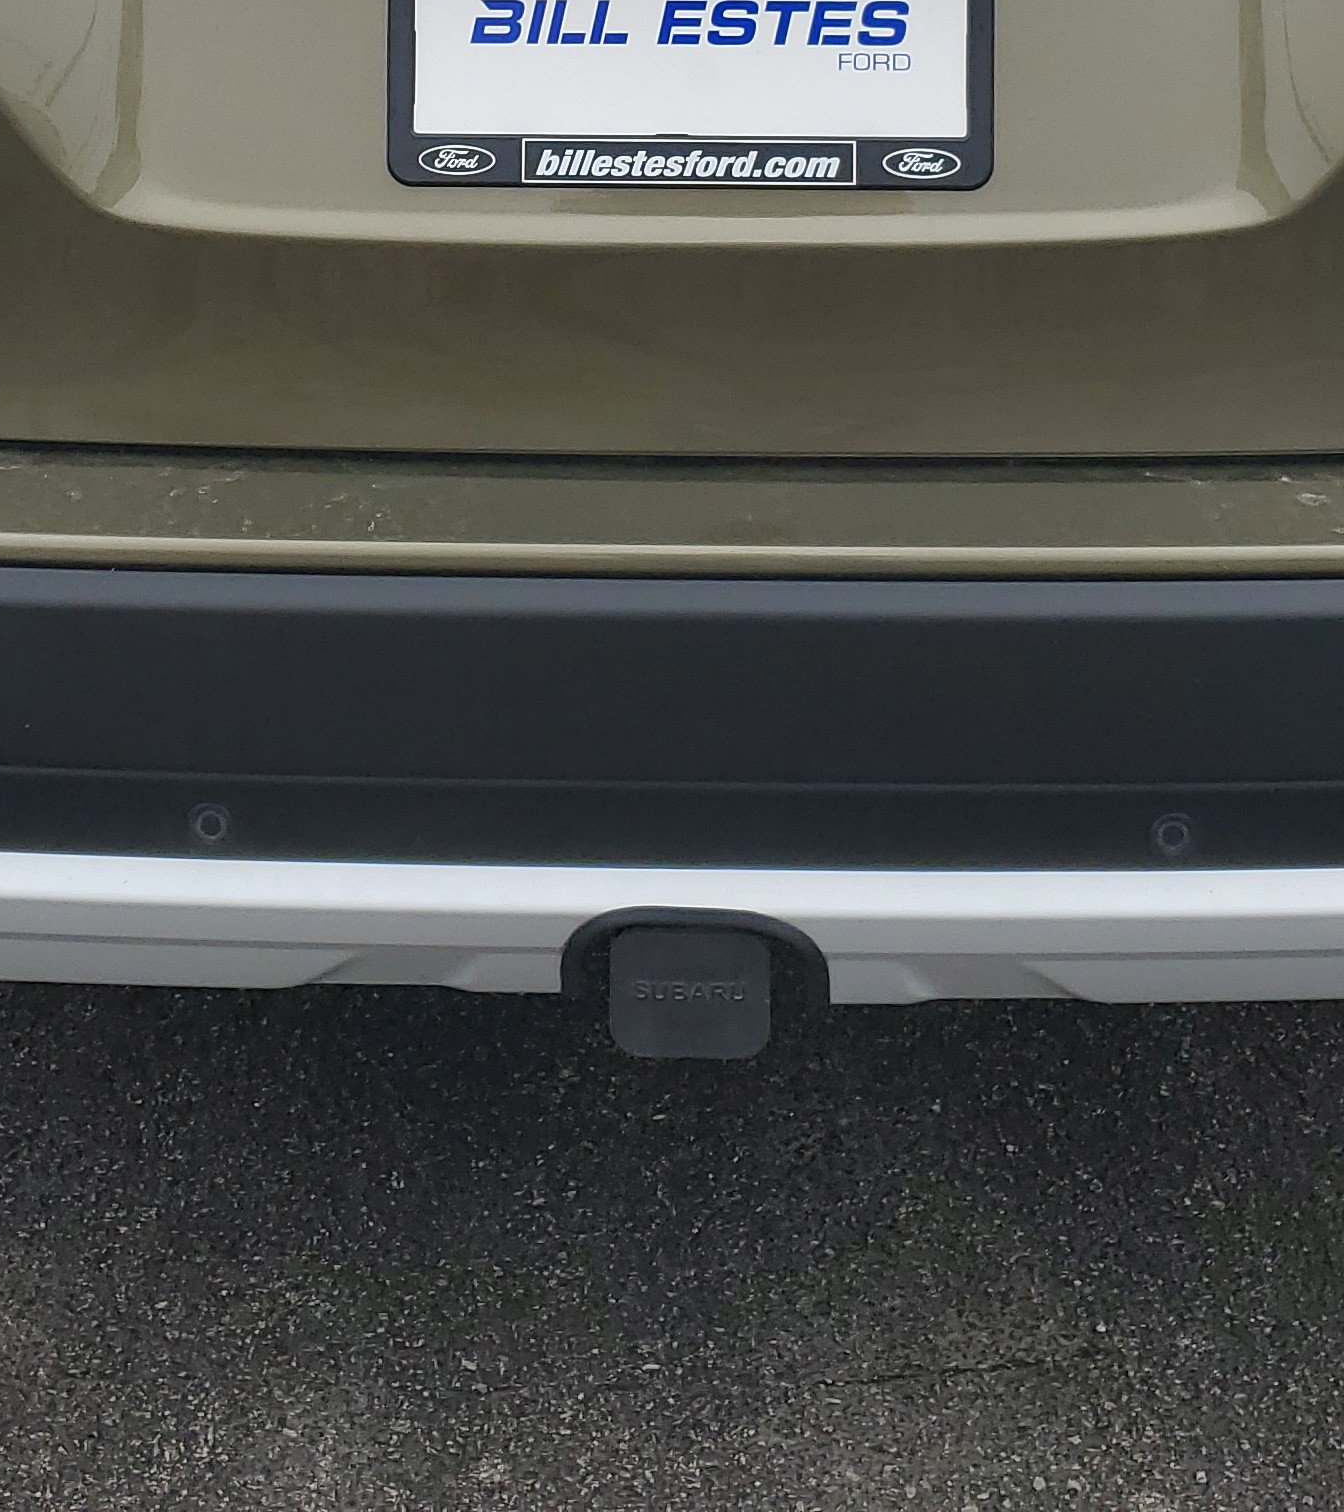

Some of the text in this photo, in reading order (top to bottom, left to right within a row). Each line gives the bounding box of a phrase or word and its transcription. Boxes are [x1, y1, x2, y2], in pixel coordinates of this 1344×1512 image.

[470, 0, 911, 46] BILL ESTES
[837, 52, 912, 72] FORD
[434, 148, 480, 172] Ford
[536, 148, 840, 180] billestesford.com
[897, 151, 946, 175] Ford
[634, 979, 746, 1001] SUBARU
